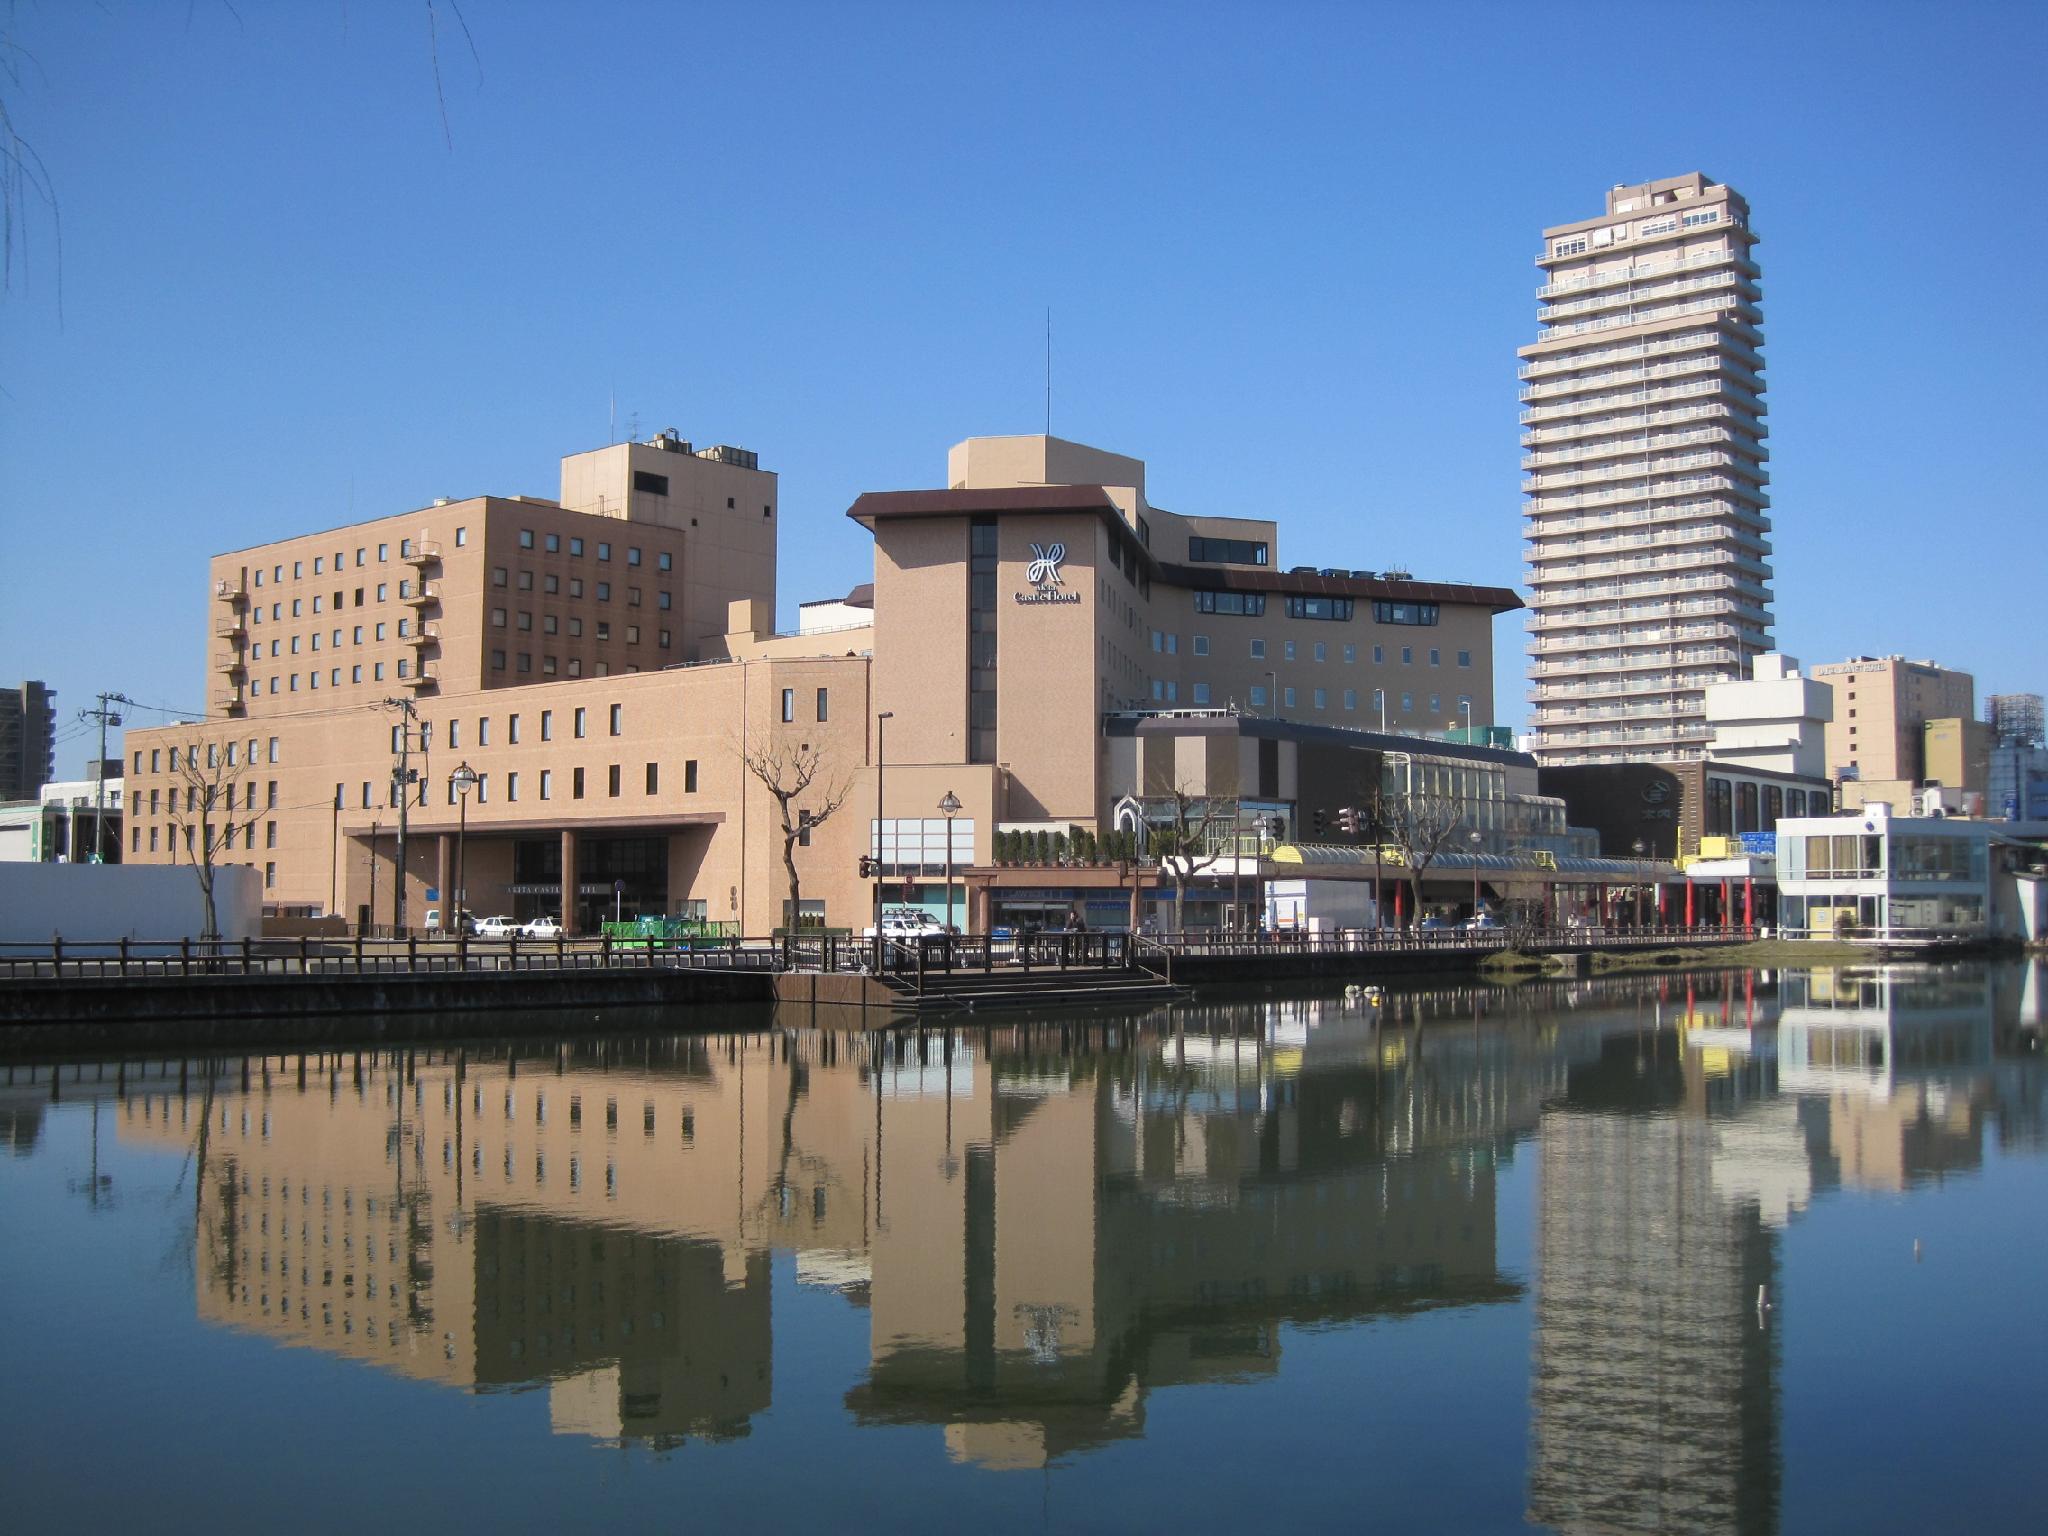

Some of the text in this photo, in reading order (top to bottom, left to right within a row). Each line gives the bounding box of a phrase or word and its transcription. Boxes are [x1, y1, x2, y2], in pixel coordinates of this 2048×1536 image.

[1013, 591, 1077, 601] Castle Hotel
[507, 886, 532, 894] AKITA
[534, 886, 561, 894] CASTL
